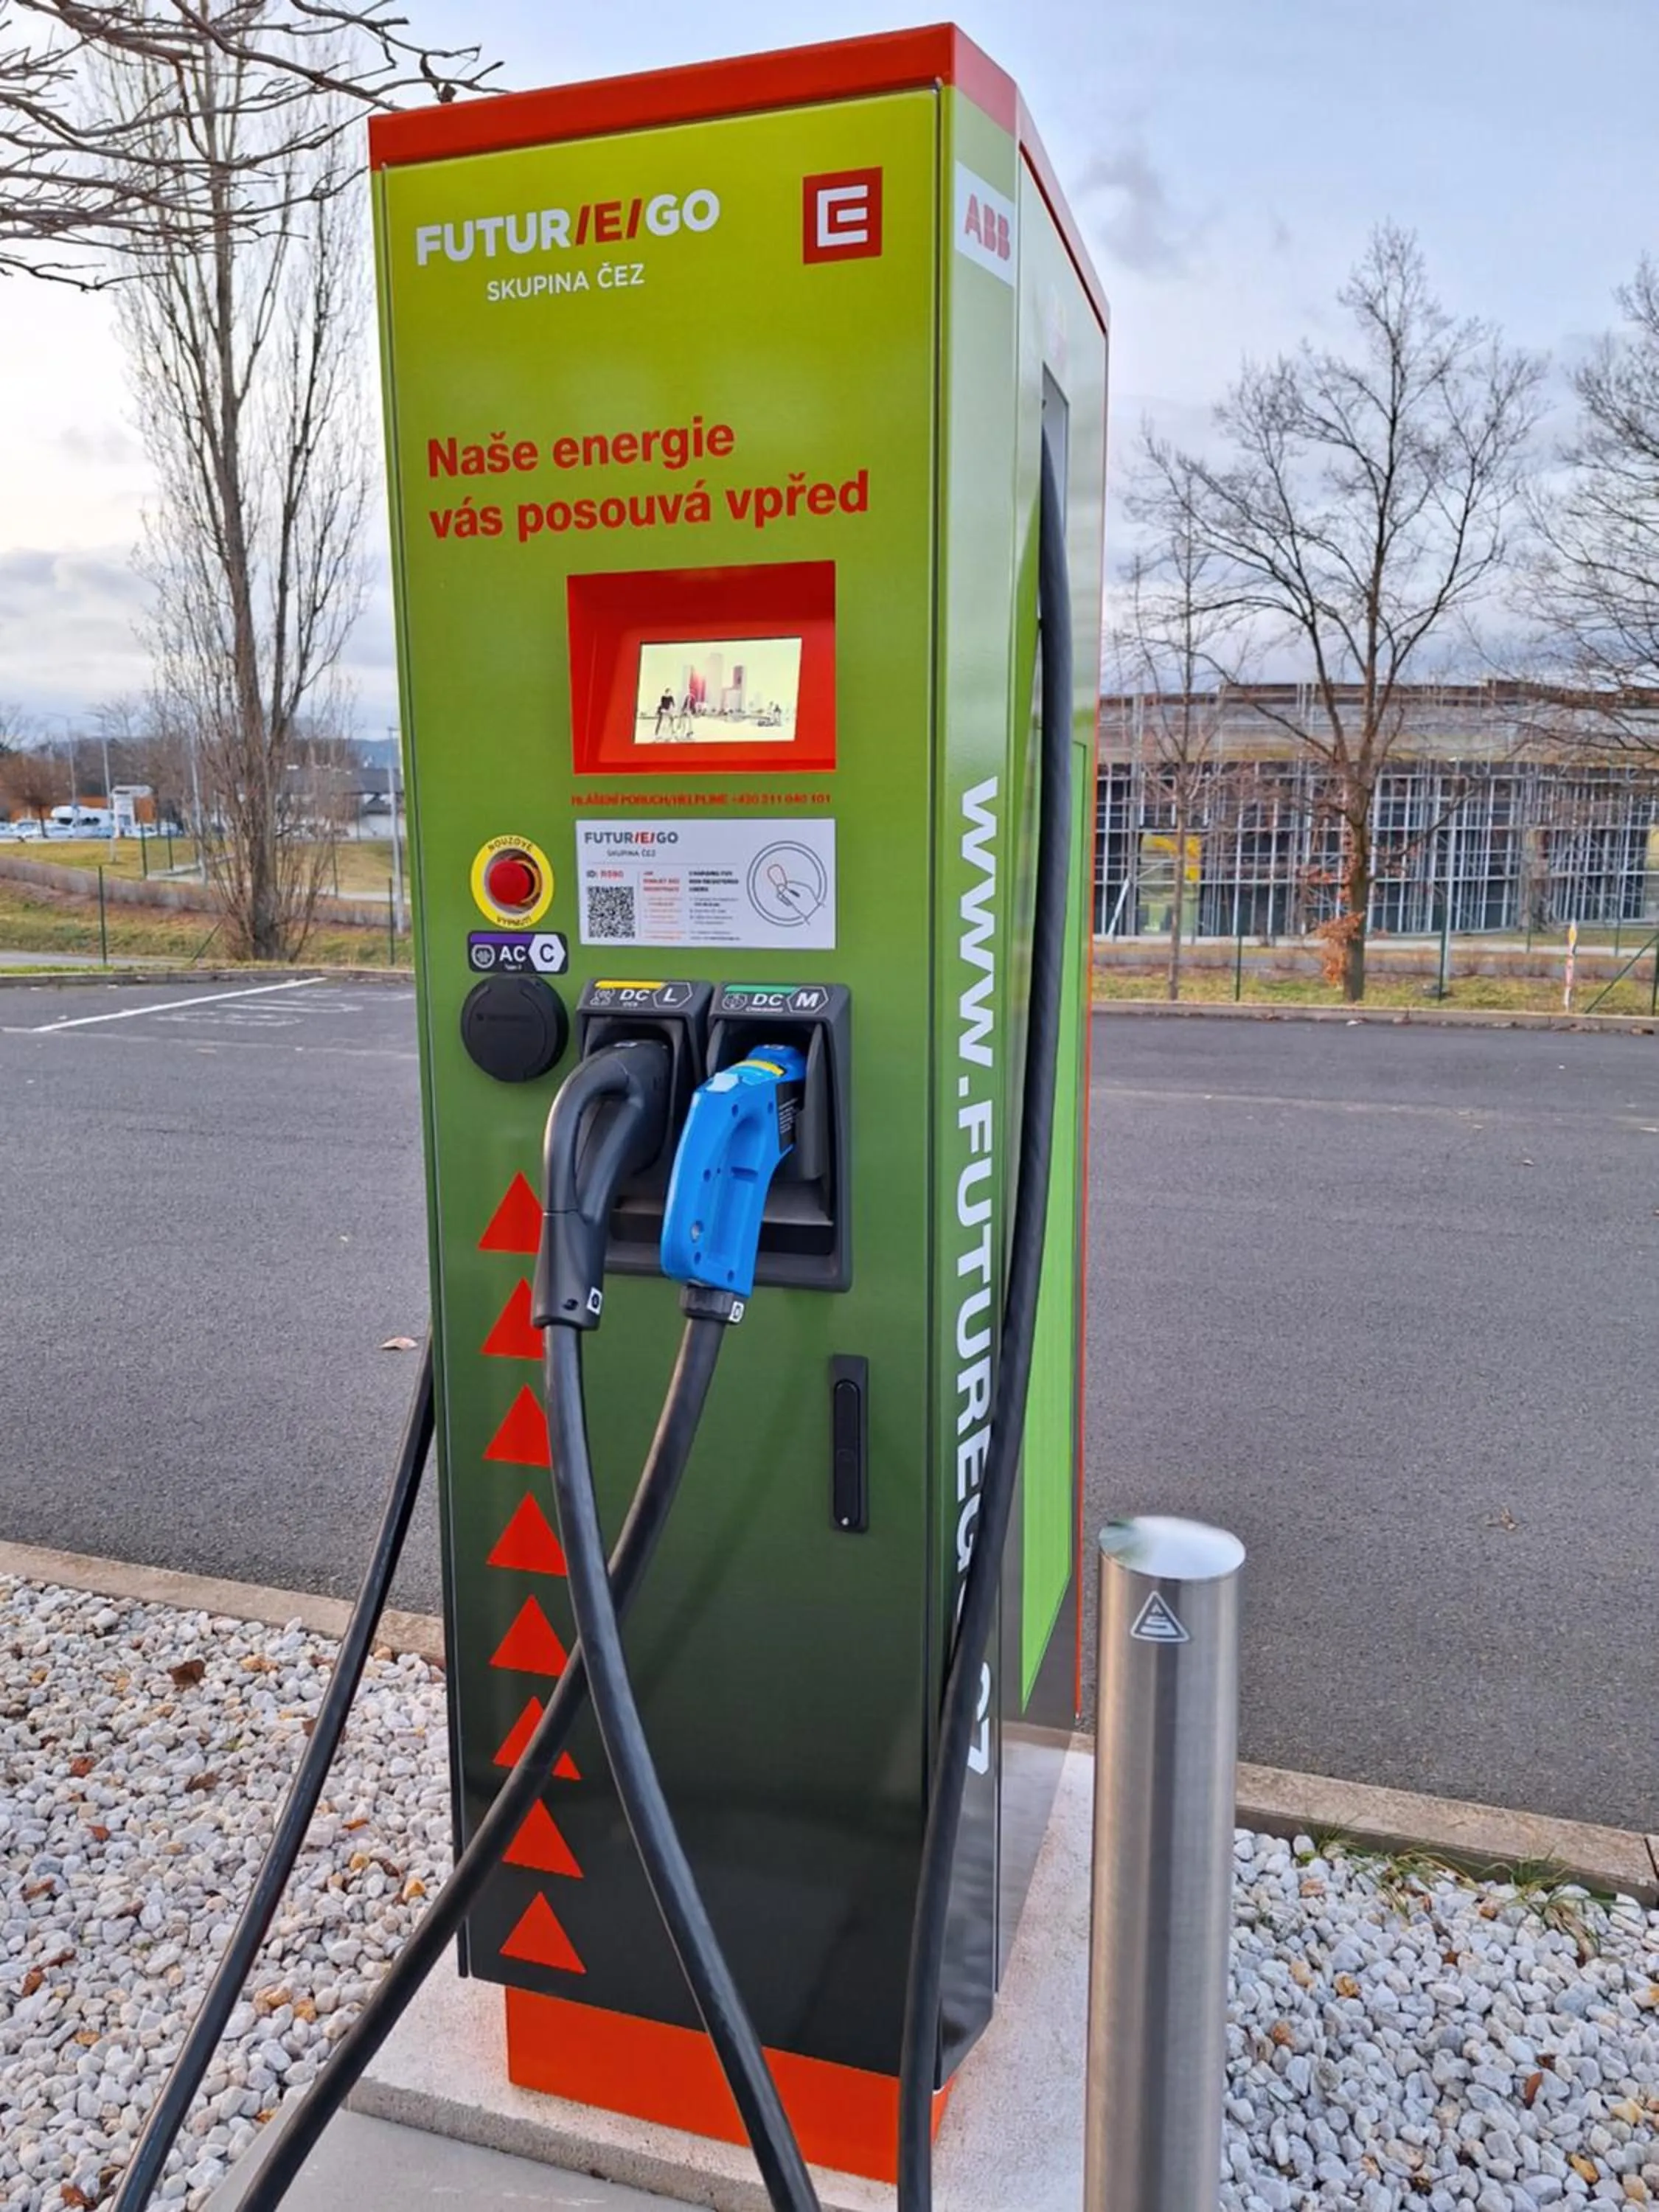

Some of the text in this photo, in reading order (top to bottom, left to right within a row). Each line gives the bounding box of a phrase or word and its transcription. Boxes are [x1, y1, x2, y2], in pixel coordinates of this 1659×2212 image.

[415, 188, 721, 266] FUTUR/E/GO
[964, 192, 1011, 261] ABB
[486, 262, 645, 302] SKUPINA ČEZ
[428, 414, 736, 478] Naše energie
[429, 469, 870, 543] vás posouvá vpřed
[499, 944, 554, 963] AC C
[619, 987, 678, 1002] DC L
[752, 992, 819, 1008] DC M
